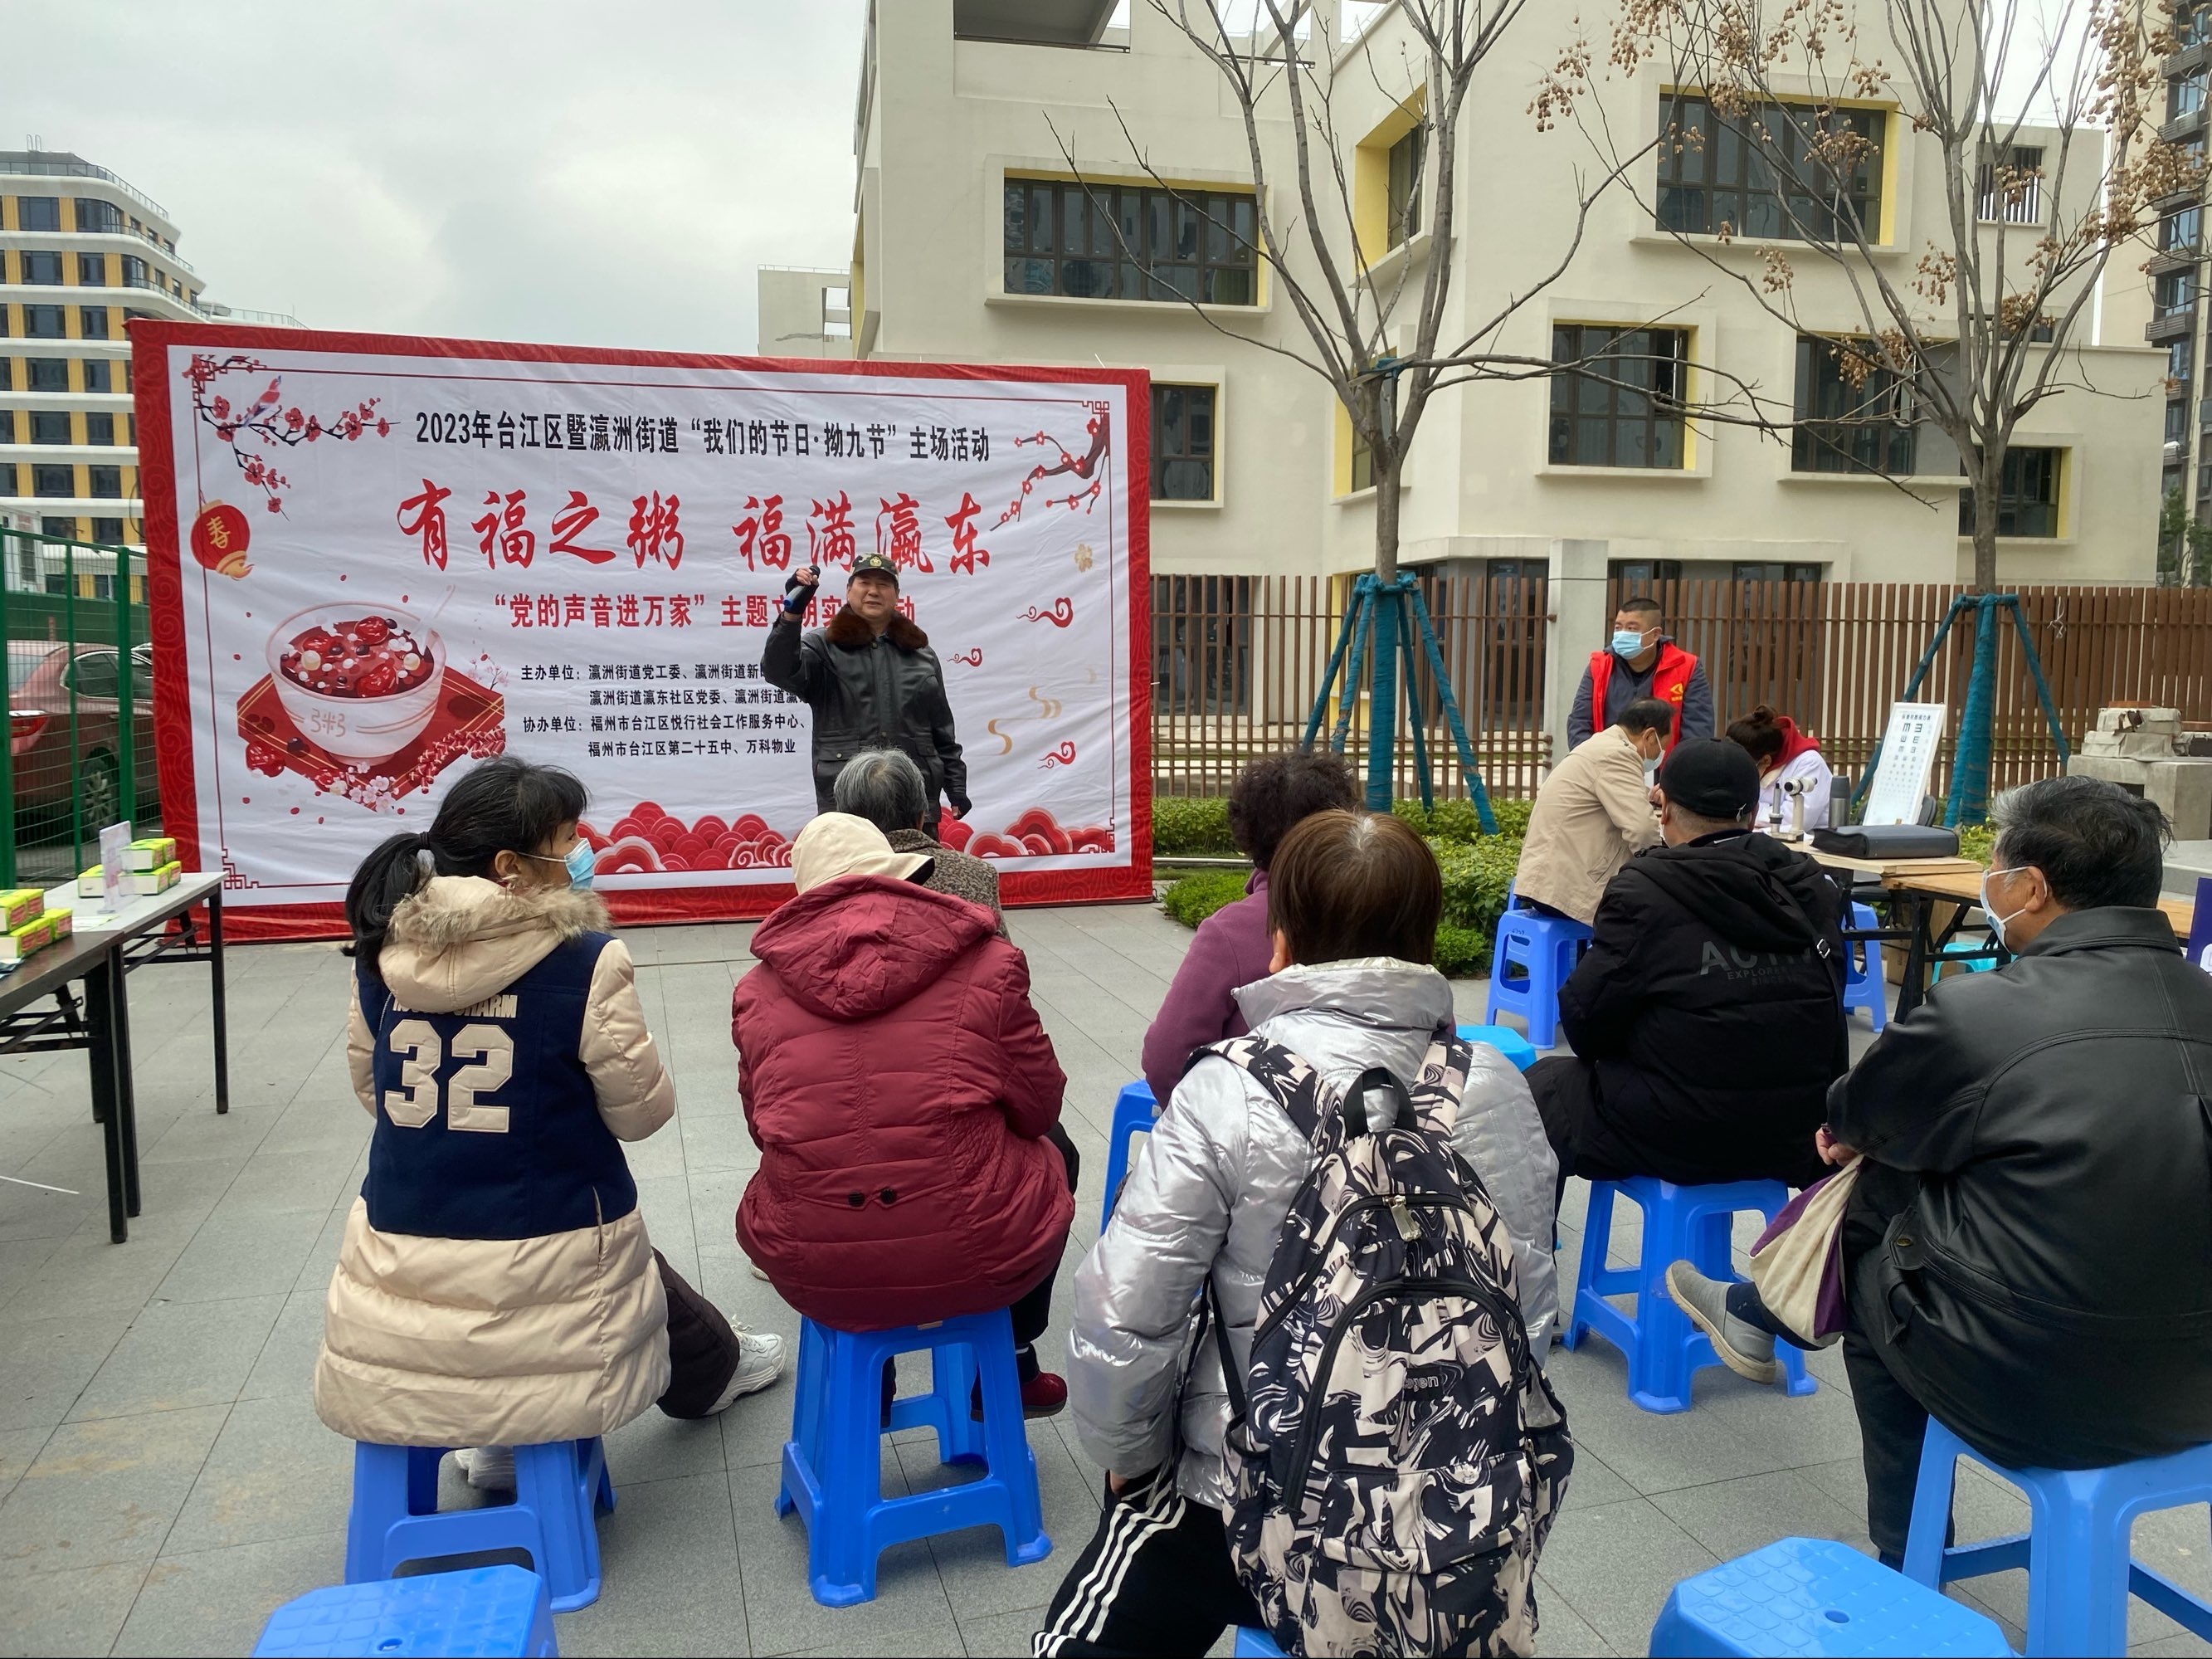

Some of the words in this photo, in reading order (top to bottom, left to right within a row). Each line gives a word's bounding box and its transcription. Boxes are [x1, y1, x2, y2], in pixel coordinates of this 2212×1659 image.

[397, 478, 685, 571] 有福之粥
[732, 490, 991, 575] 福满瀛东
[589, 689, 804, 705] 瀛洲街道瀛东社区党委、瀛洲街道瀛
[384, 1019, 514, 1133] 32
